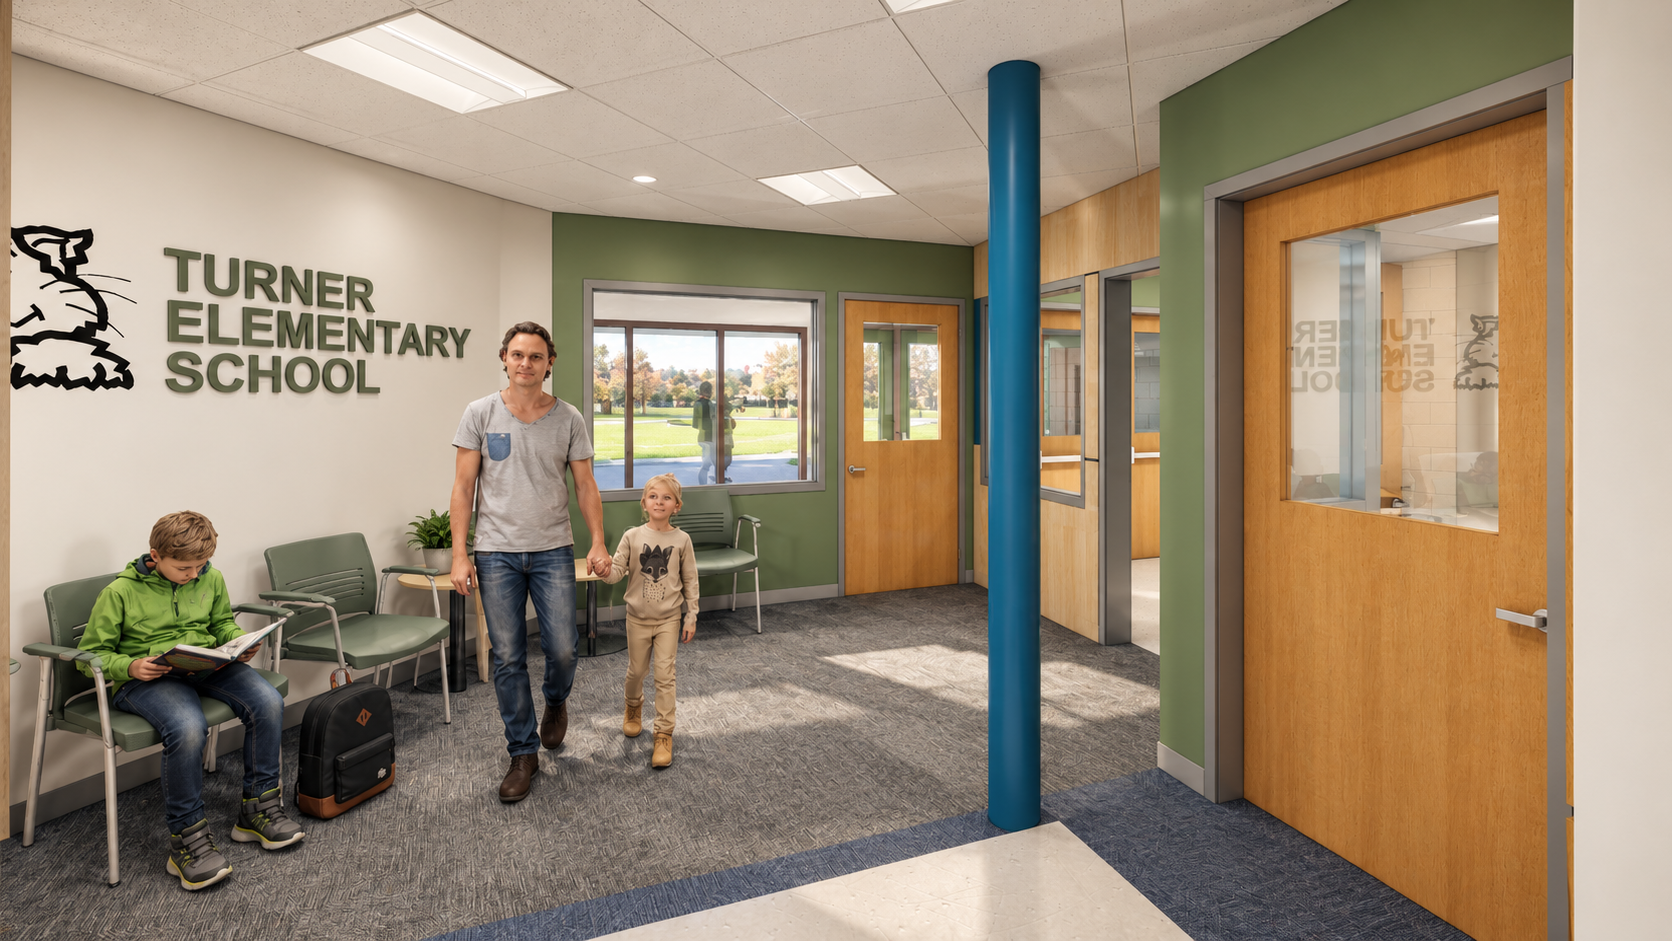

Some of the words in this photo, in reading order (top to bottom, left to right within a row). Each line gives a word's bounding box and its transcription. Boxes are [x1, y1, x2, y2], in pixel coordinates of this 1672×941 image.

[163, 247, 376, 313] TURNER
[167, 299, 472, 358] ELEMENTARY
[165, 351, 381, 394] SCHOOL
